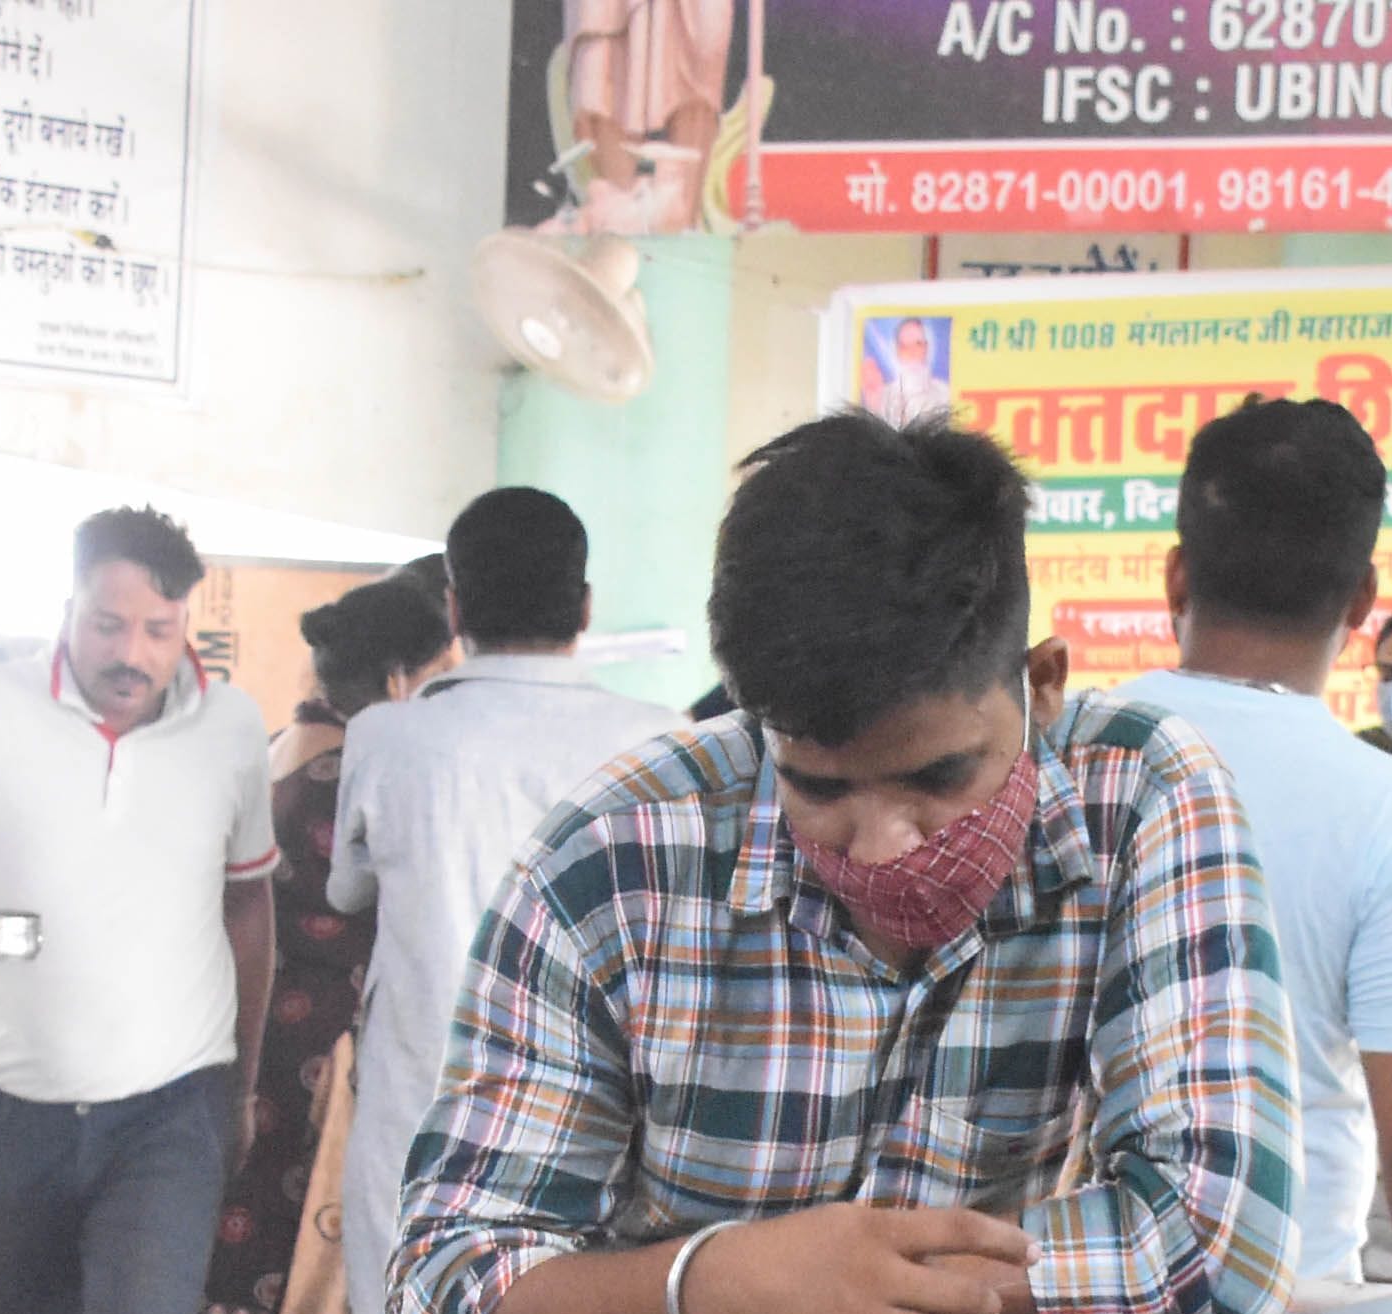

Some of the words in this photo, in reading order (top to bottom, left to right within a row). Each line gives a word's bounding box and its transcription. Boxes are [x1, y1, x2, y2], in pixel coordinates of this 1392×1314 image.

[936, 0, 1034, 62] A/C
[1052, 0, 1147, 55] No.
[1041, 64, 1172, 124] IFSC
[845, 160, 898, 217] मो.
[910, 170, 1204, 218] 82871-00001,
[1047, 319, 1116, 351] 1008
